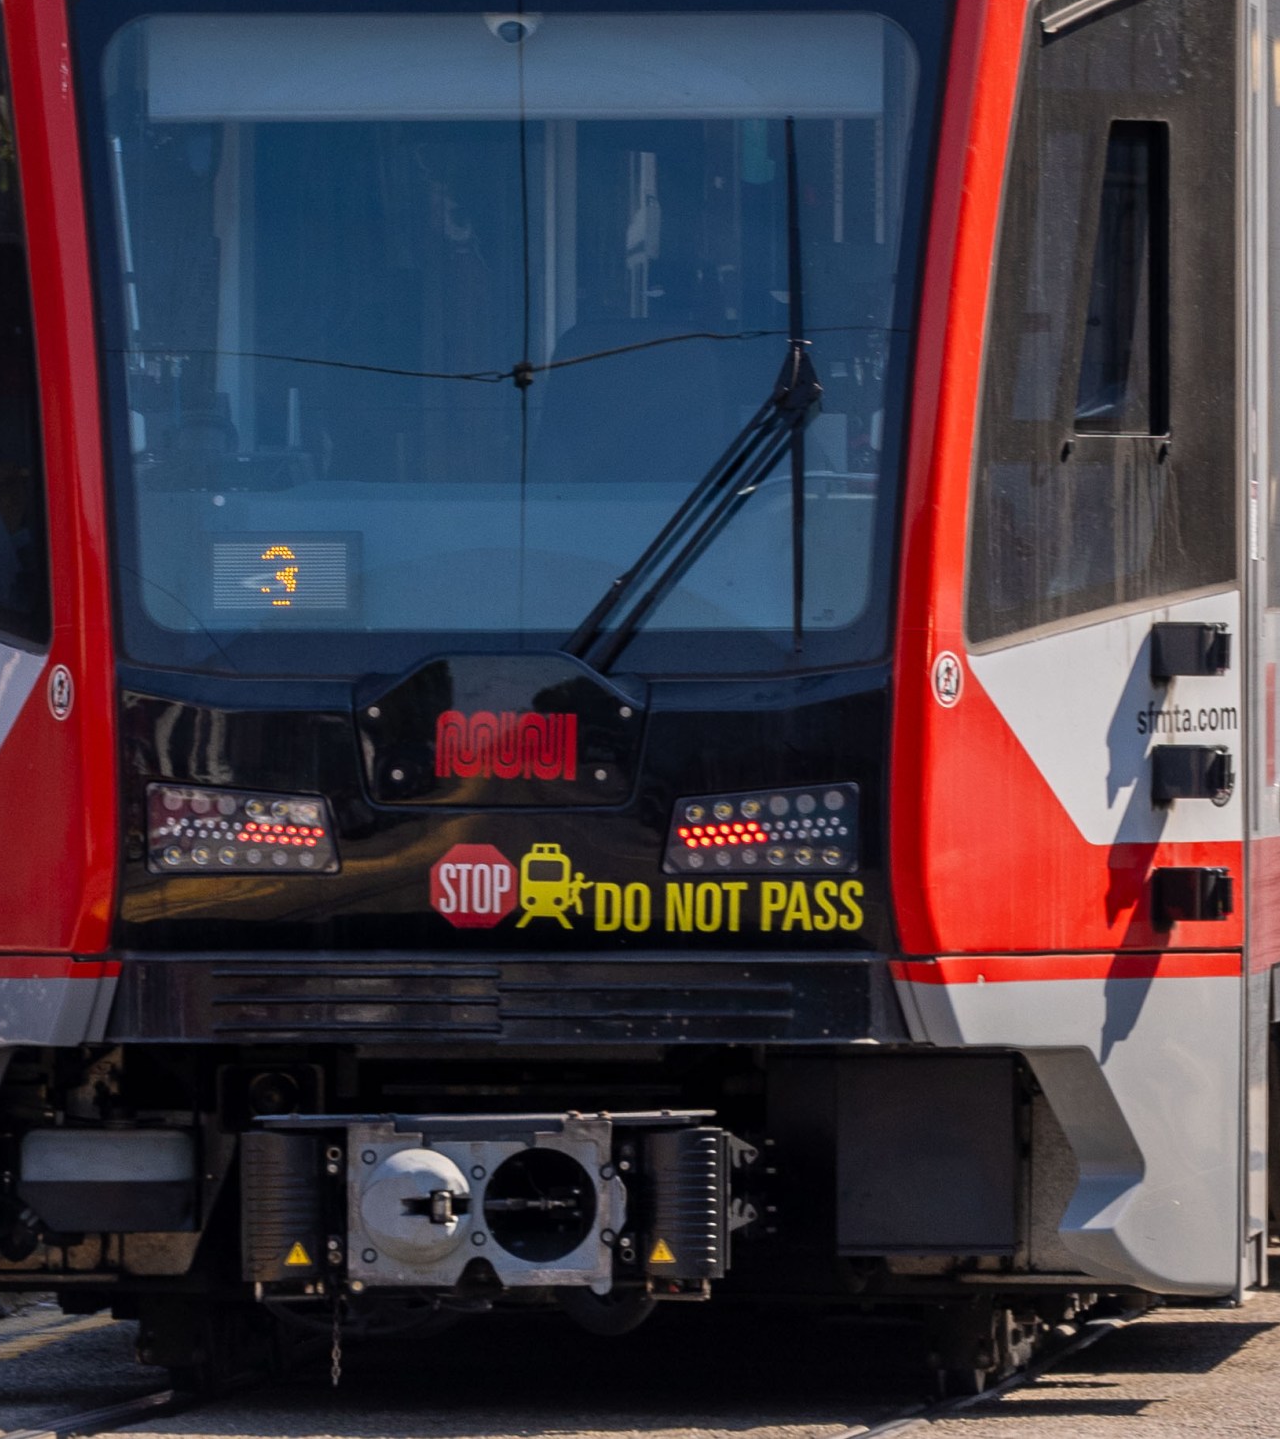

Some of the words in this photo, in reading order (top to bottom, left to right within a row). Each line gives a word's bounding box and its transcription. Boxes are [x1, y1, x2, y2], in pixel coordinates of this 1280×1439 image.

[1136, 700, 1238, 735] sfmta.com
[438, 862, 511, 914] STOP
[594, 882, 651, 932] DO
[665, 882, 749, 932] NOT
[760, 880, 865, 932] PASS
